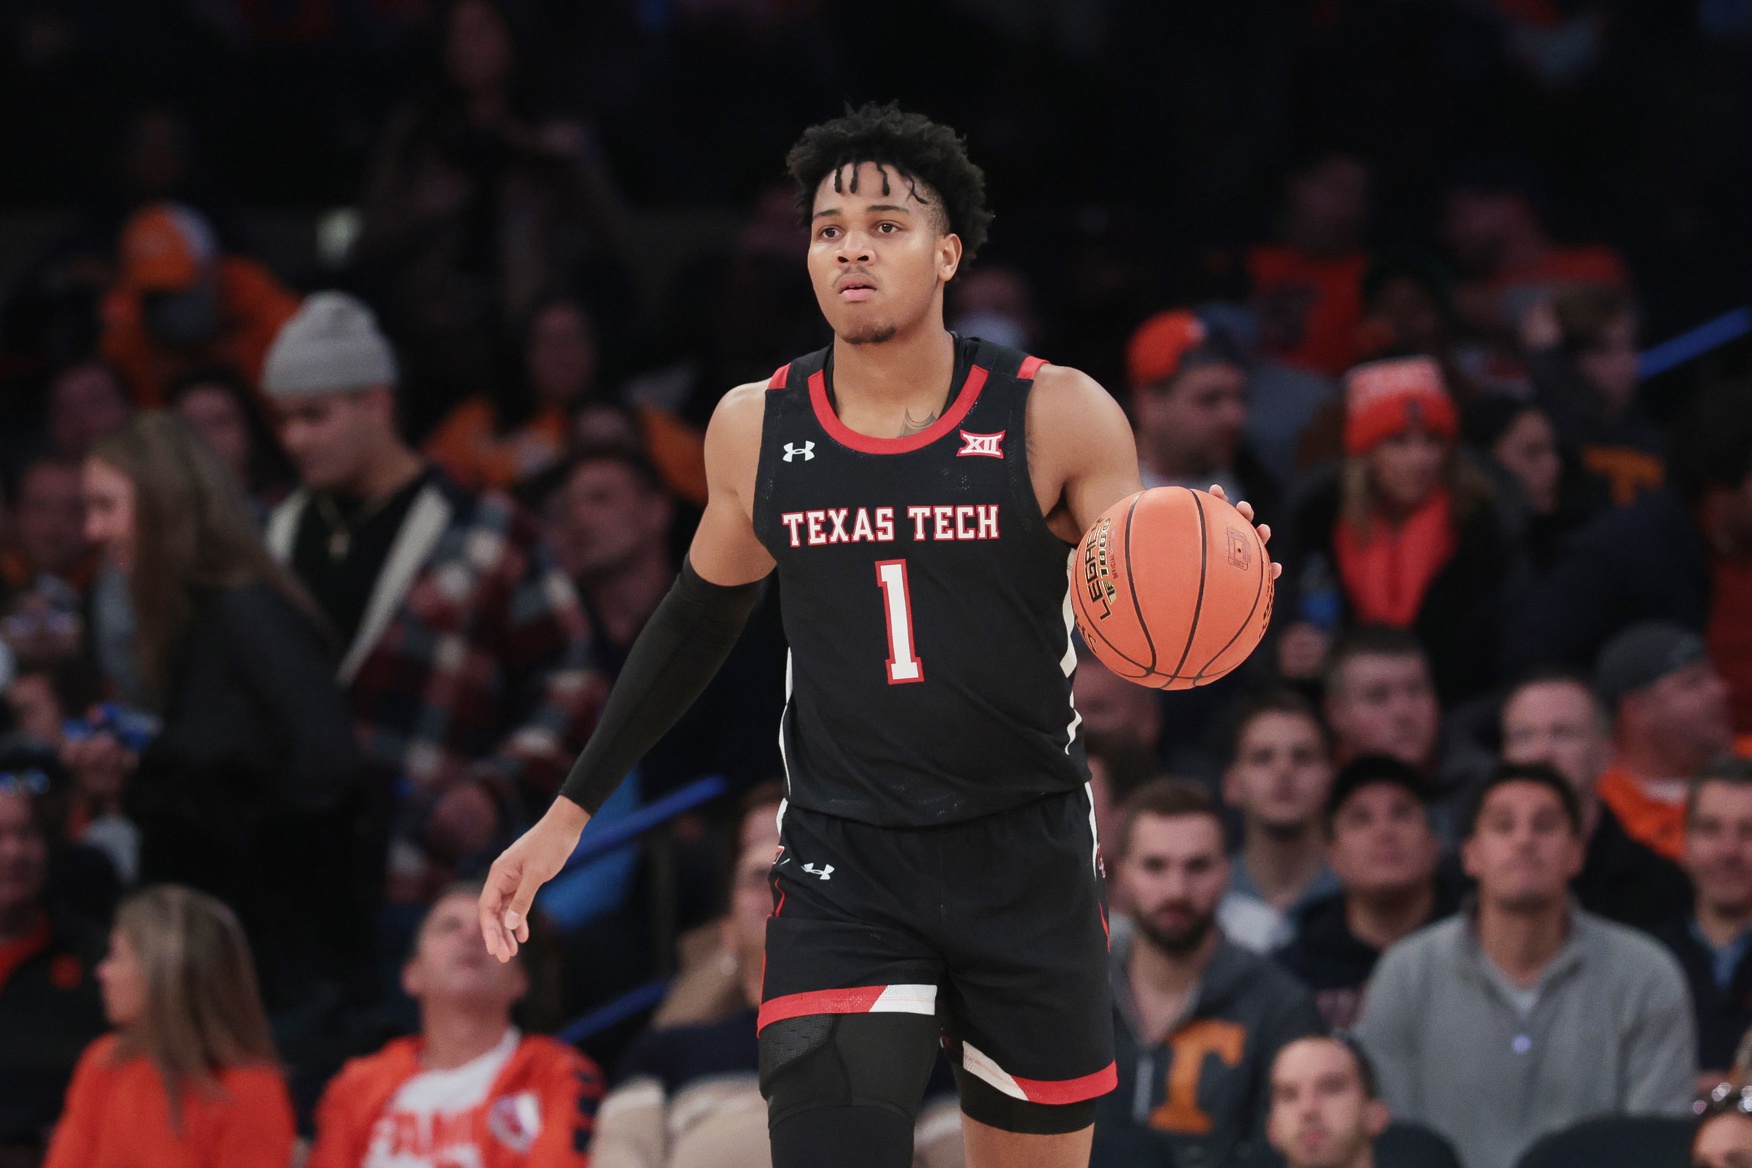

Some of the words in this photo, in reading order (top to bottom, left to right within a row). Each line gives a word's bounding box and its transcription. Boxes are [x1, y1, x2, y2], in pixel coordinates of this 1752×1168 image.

[781, 507, 895, 547] TEXAS
[907, 504, 1000, 541] TECH
[875, 559, 925, 685] 1
